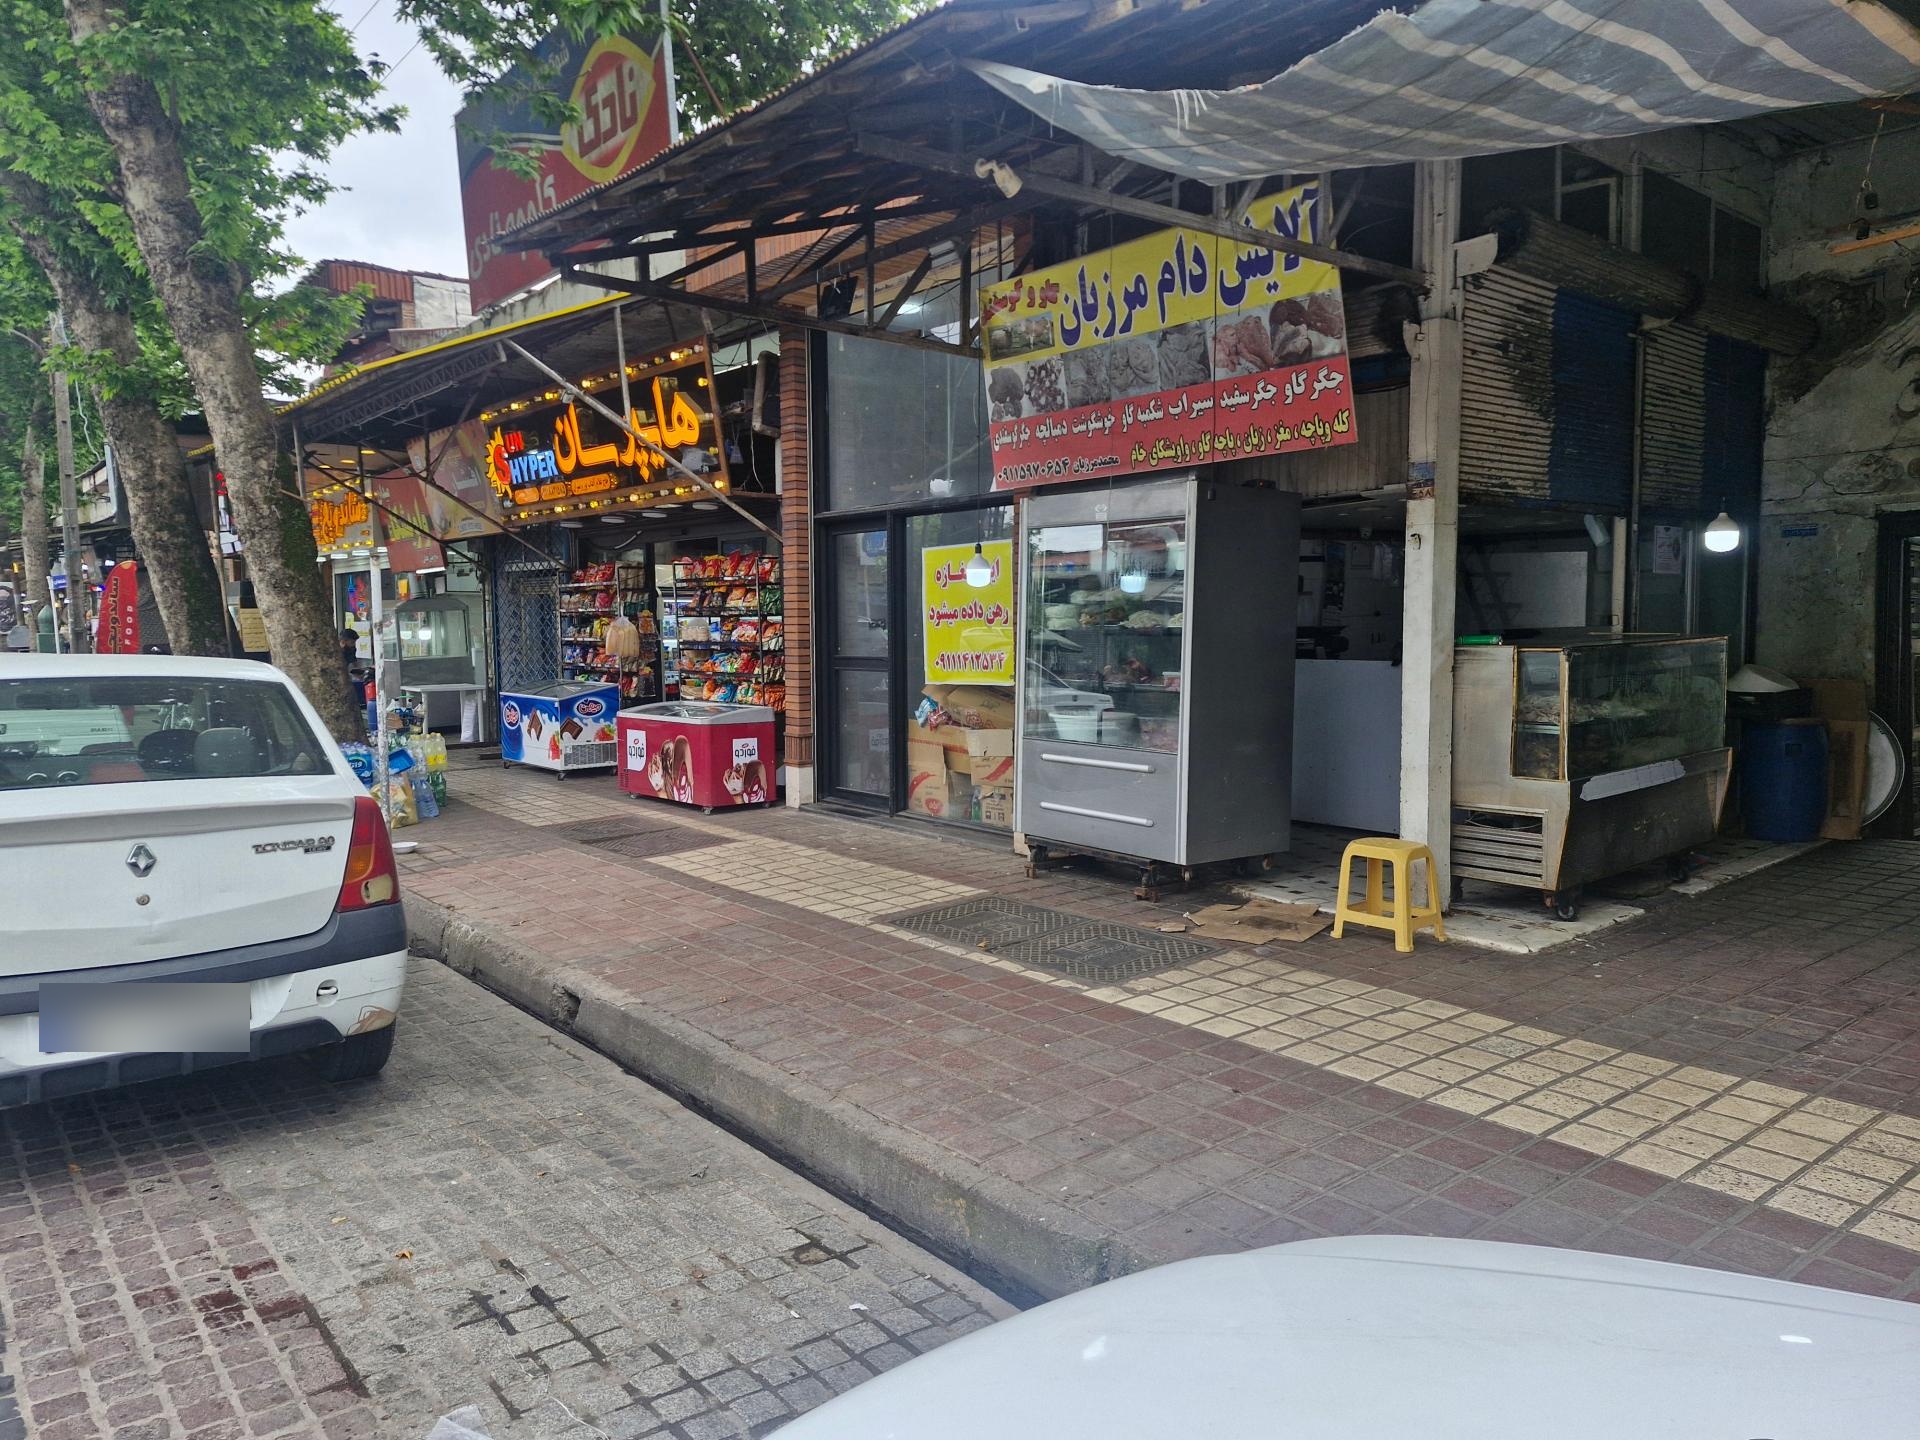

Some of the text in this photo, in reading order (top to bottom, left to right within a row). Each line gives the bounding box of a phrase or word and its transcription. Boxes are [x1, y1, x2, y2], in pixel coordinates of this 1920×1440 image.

[1157, 234, 1208, 324] دام
[1059, 264, 1149, 347] مرزبان
[1251, 378, 1279, 410] جگر
[1284, 368, 1309, 405] گاو
[1310, 365, 1345, 400] جگر
[1136, 399, 1164, 427] شکمبه
[1220, 383, 1250, 414] سفید
[1121, 402, 1134, 433] گاو
[1333, 409, 1350, 434] کله
[553, 402, 620, 475] سان
[1197, 430, 1212, 461] گاو
[509, 450, 559, 485] HYPER
[1131, 441, 1147, 470] خام
[935, 561, 968, 589] غازه
[928, 600, 1009, 627] رهن داده میشود
